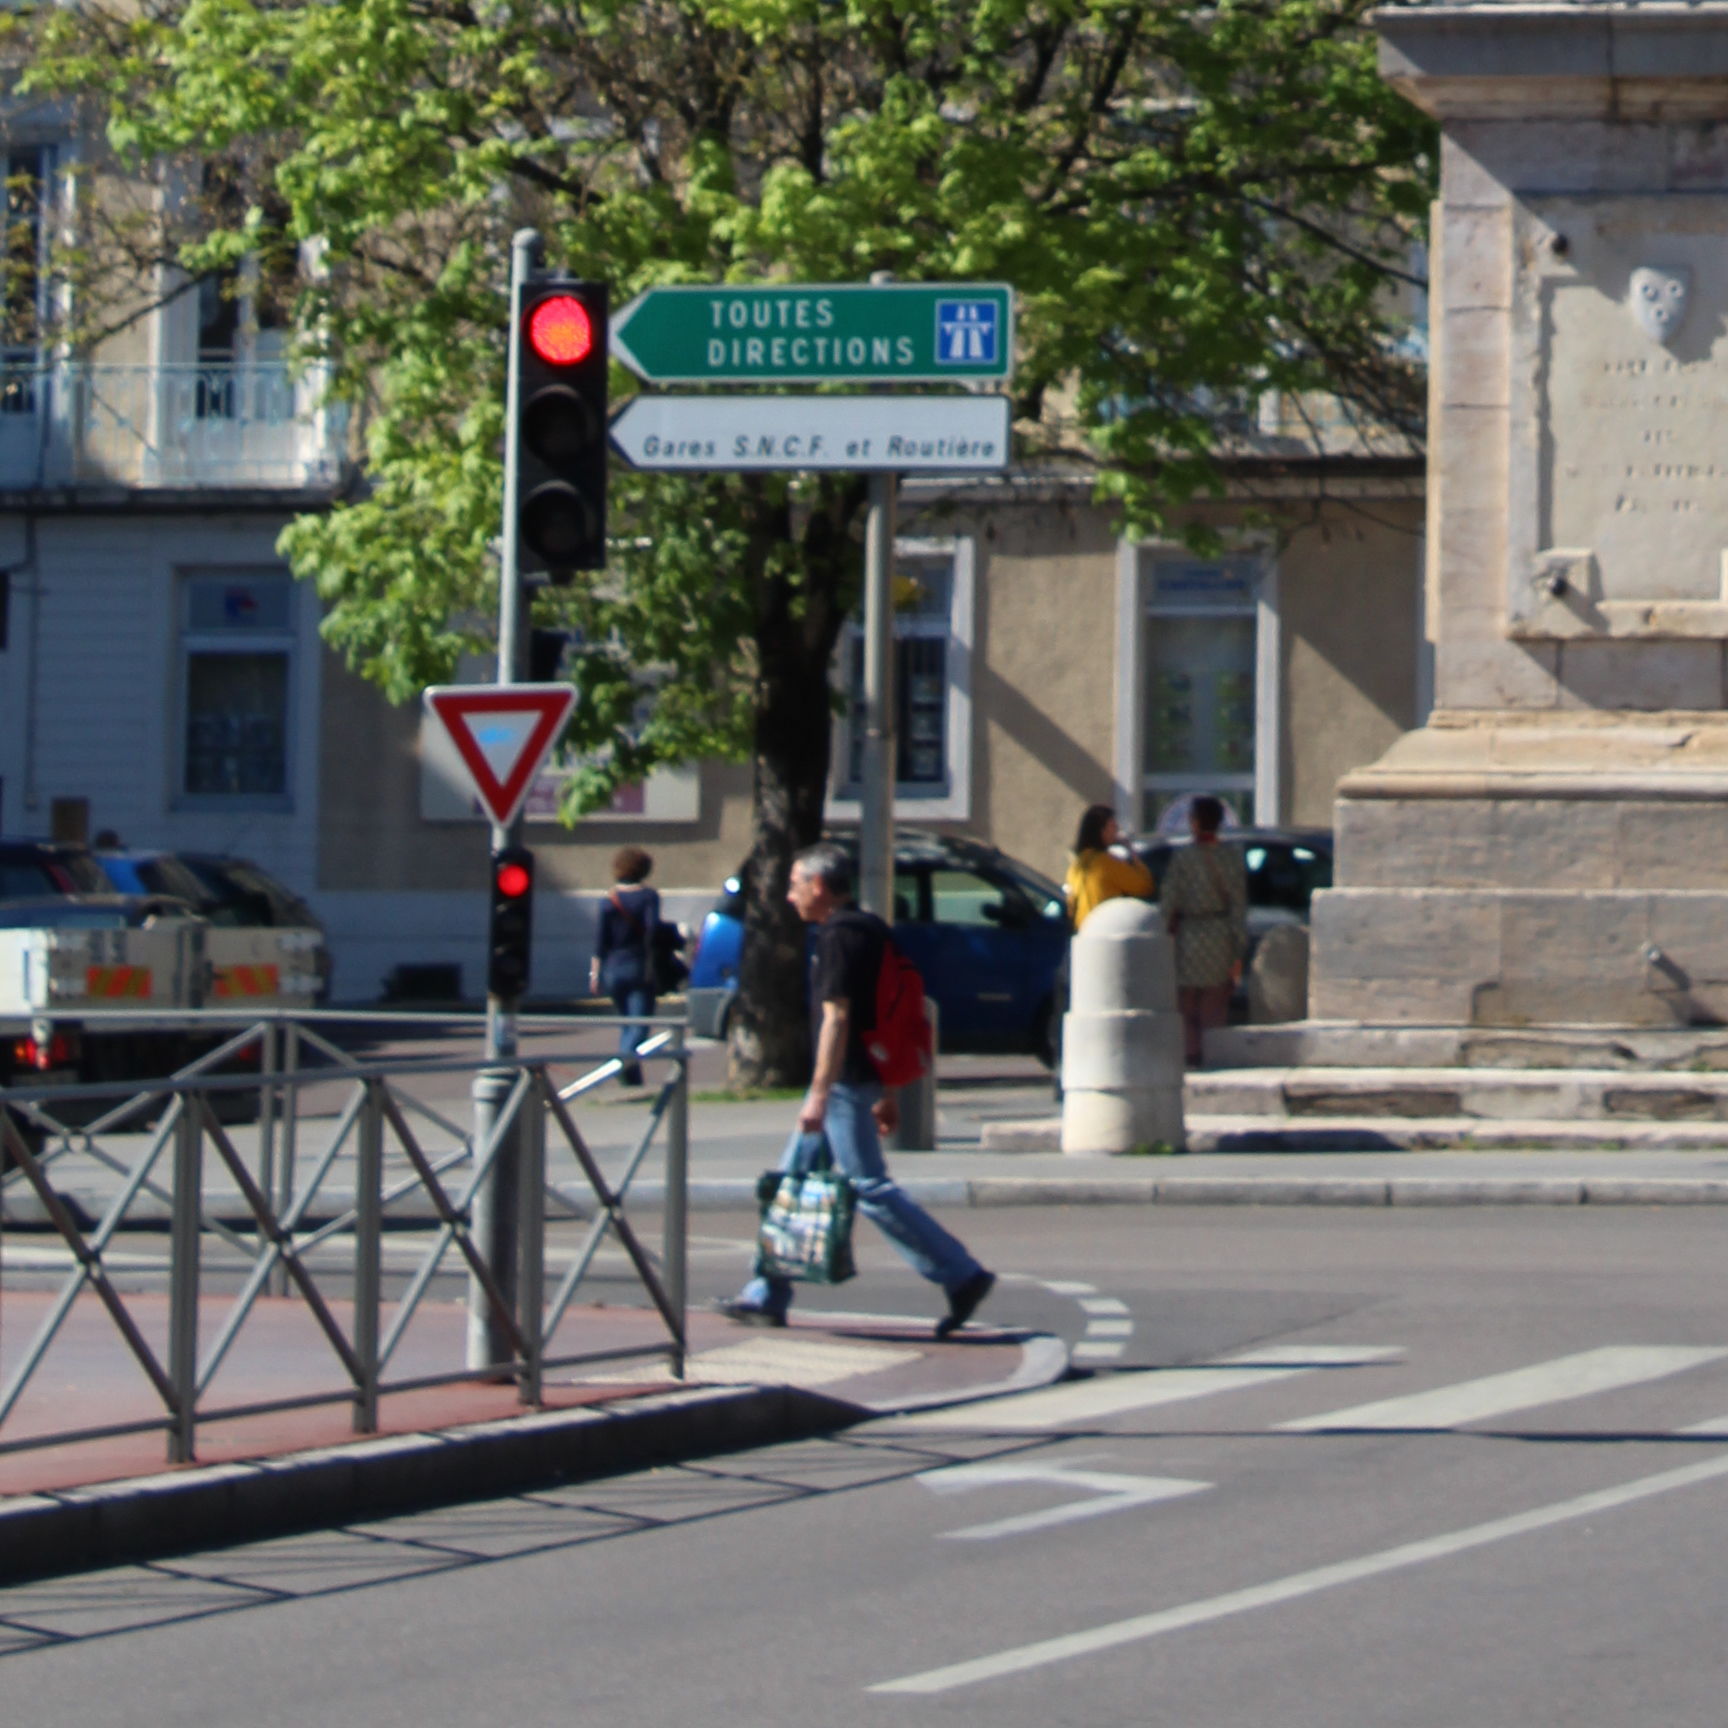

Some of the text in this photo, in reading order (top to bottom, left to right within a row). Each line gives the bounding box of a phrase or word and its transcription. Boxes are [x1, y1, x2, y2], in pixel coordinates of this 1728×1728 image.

[709, 299, 834, 328] TOUTES
[707, 336, 915, 367] DIRECTIONS
[643, 434, 715, 458] Gares
[845, 435, 871, 458] et
[886, 434, 996, 458] Routière
